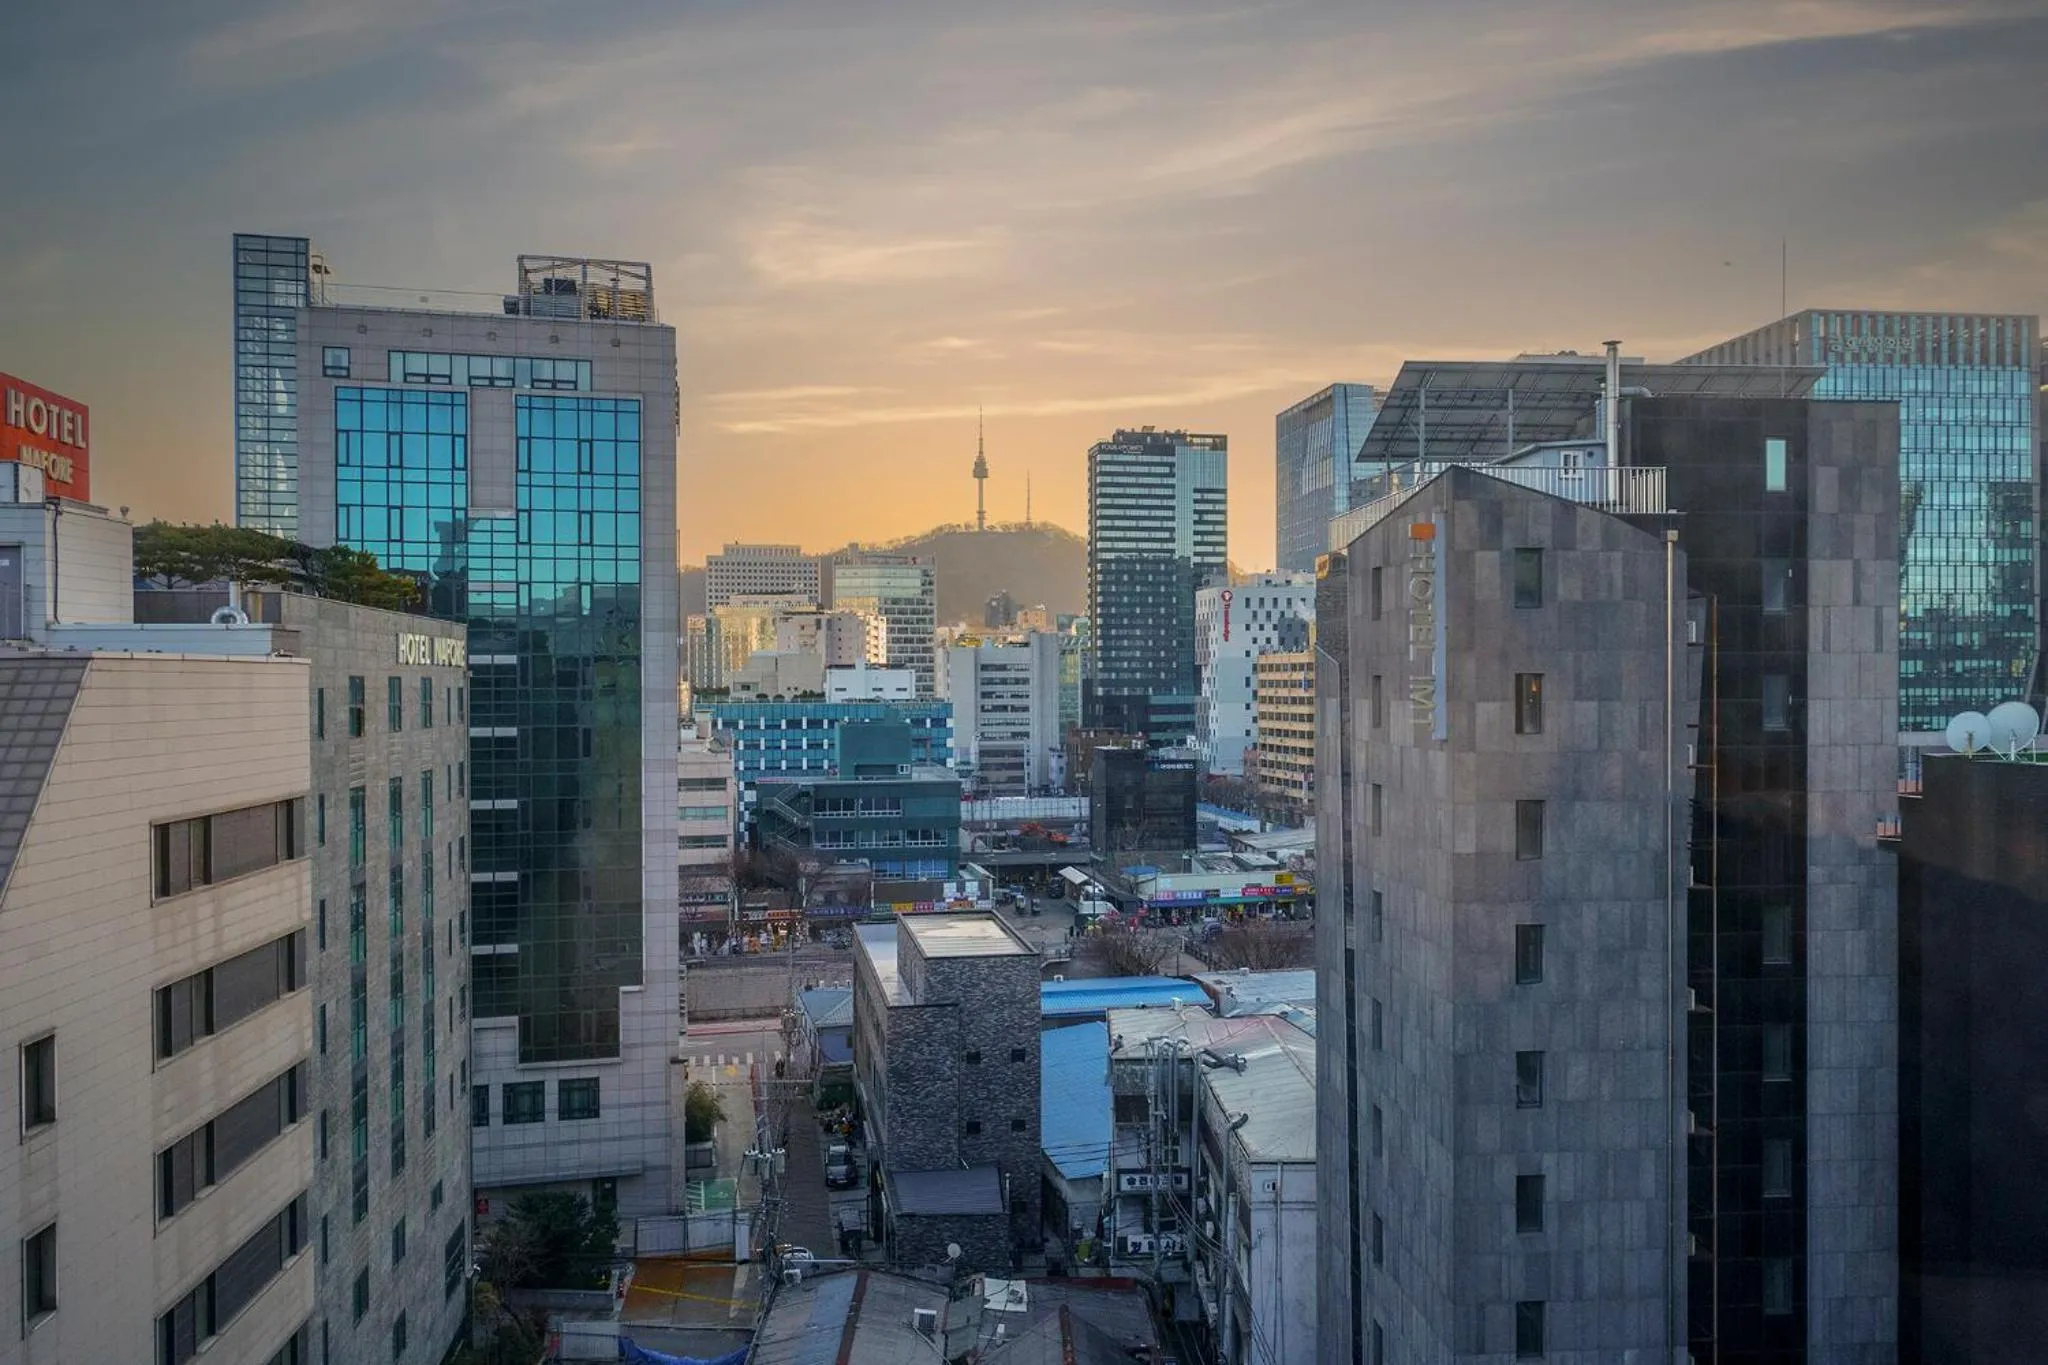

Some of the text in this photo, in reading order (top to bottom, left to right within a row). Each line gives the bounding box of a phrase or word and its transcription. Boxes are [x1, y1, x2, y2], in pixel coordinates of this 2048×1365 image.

[5, 388, 87, 449] HOTEL
[1409, 552, 1436, 662] HOTEL
[396, 631, 431, 666] HOTEL
